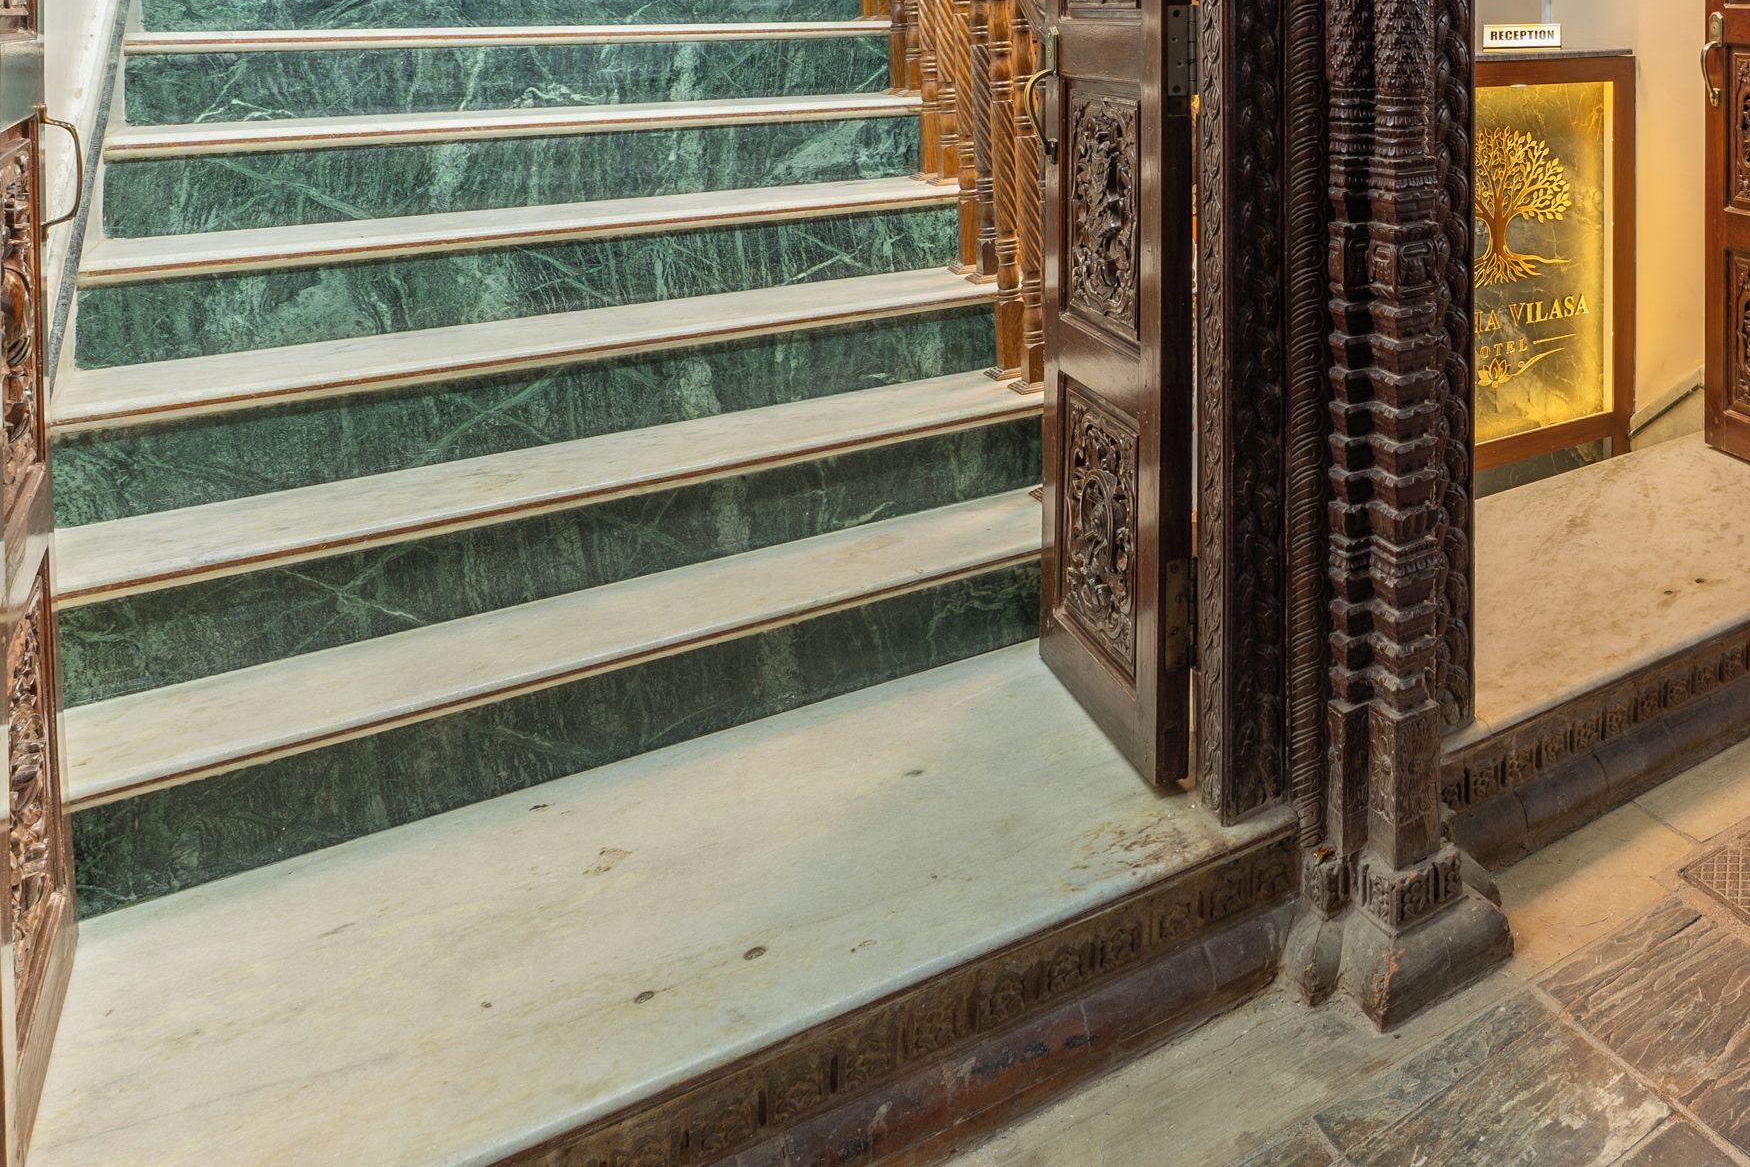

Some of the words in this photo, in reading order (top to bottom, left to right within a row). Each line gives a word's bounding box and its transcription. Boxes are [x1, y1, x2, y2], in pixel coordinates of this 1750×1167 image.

[1489, 29, 1556, 43] RECEPTION
[1508, 293, 1590, 327] VILASA
[1480, 338, 1528, 359] OTEL
